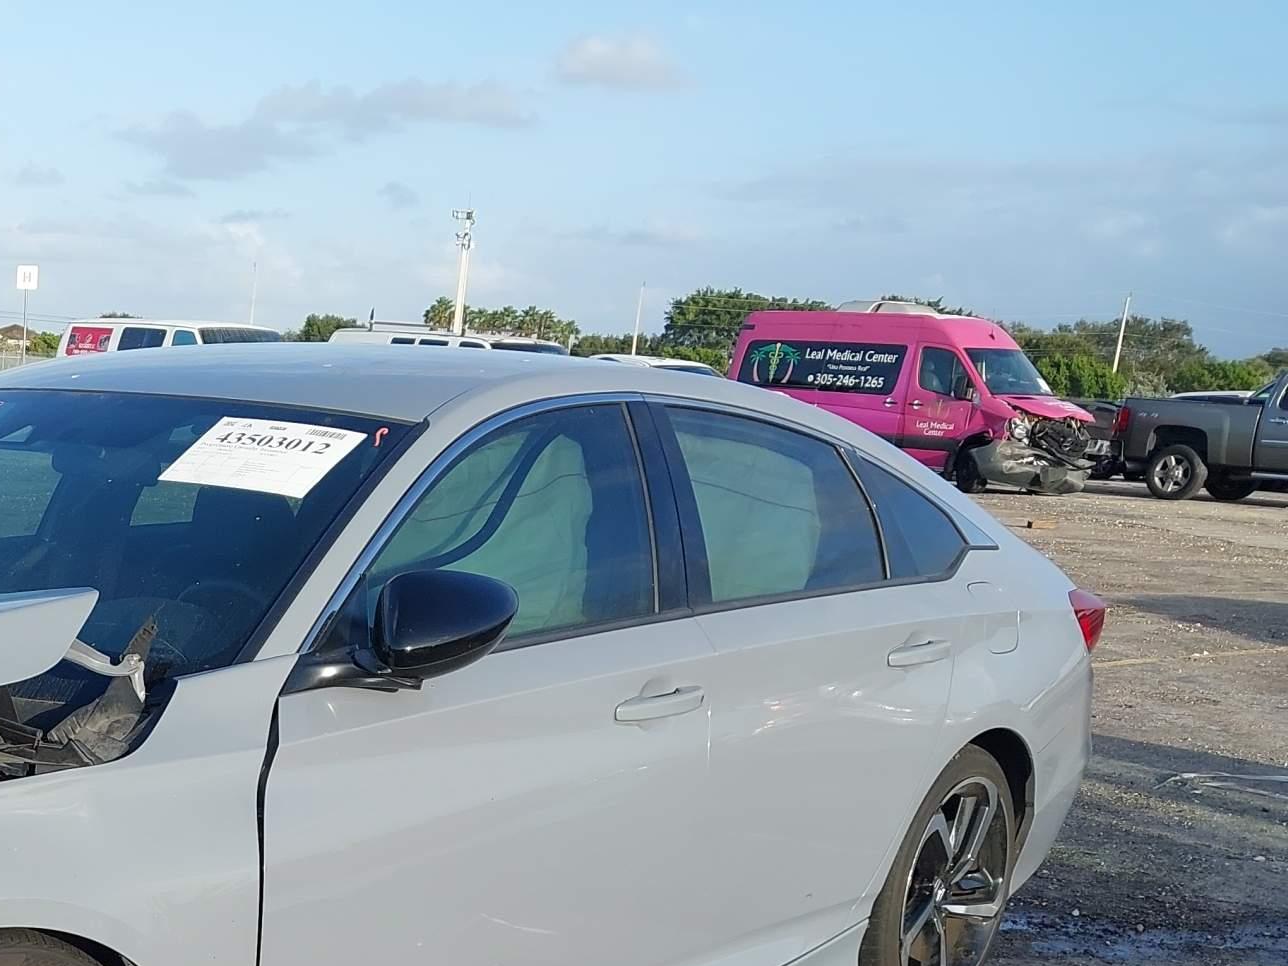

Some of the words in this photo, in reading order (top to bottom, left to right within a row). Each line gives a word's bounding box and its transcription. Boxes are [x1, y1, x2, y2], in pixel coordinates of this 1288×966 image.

[805, 347, 825, 360] Leal
[826, 348, 864, 362] Medical
[865, 350, 899, 364] Center
[814, 372, 885, 388] 305-246-1265
[916, 420, 929, 429] Leal
[930, 421, 955, 431] Medical
[923, 428, 944, 437] Center
[215, 431, 331, 455] 43503012
